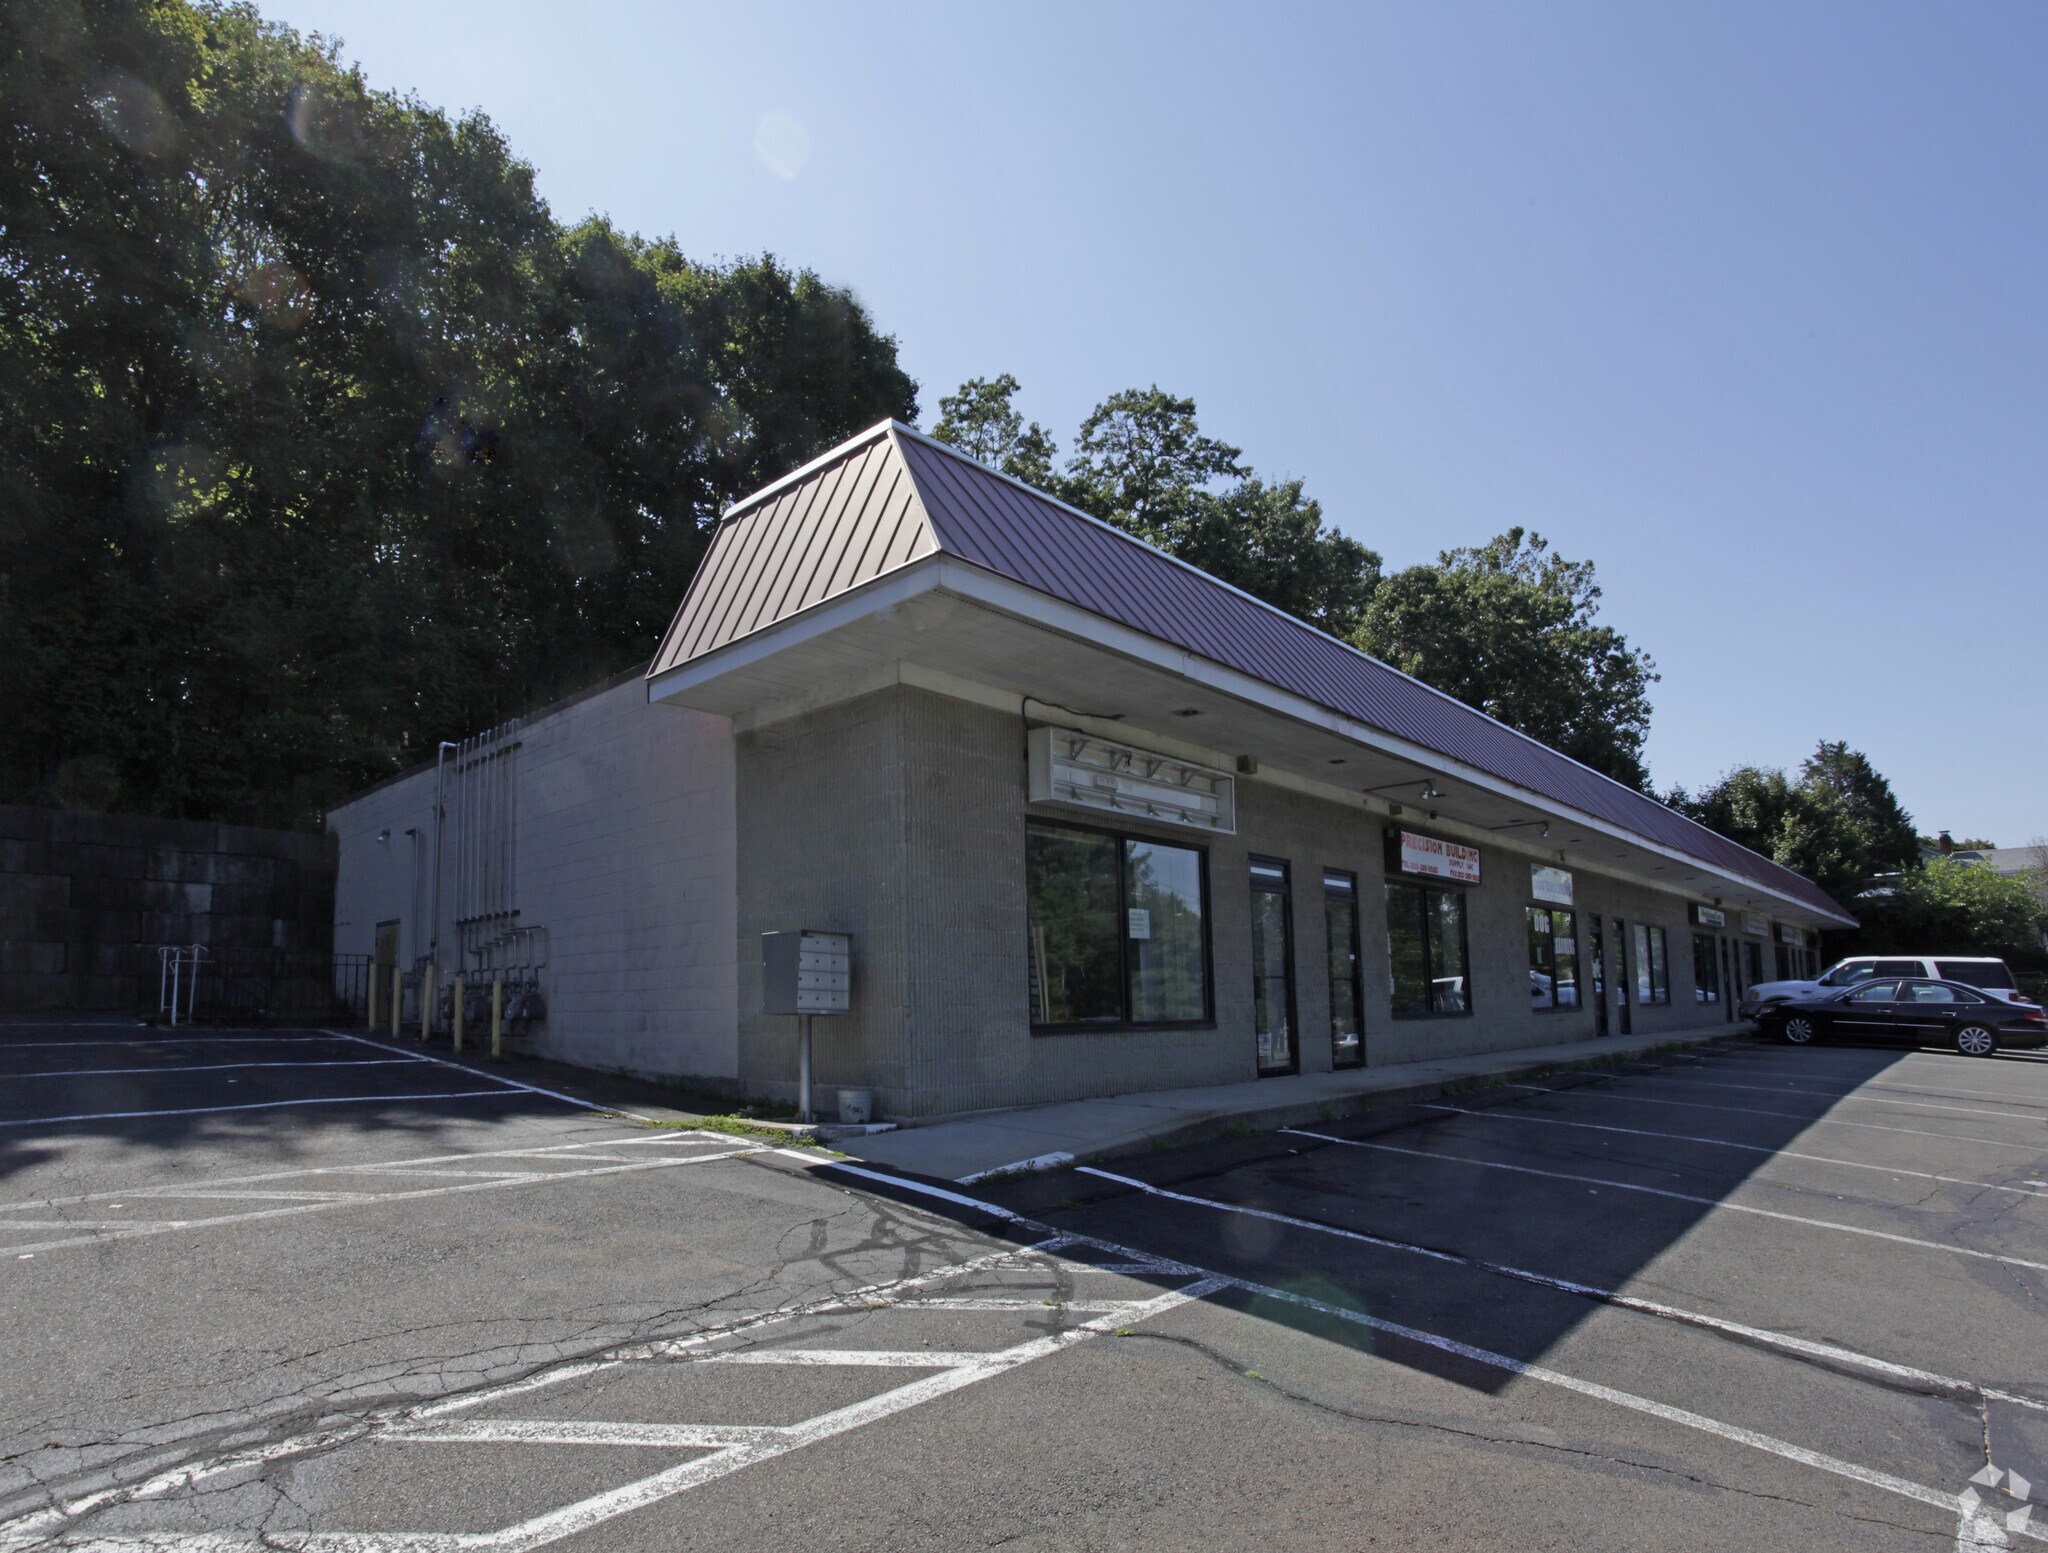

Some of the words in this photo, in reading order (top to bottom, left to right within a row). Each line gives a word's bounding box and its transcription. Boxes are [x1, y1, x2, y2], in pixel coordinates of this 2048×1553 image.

[1401, 833, 1442, 855] PRECISION
[1446, 844, 1478, 863] BUILDING
[1449, 859, 1464, 868] SUPPLY
[1534, 914, 1550, 933] DOG
